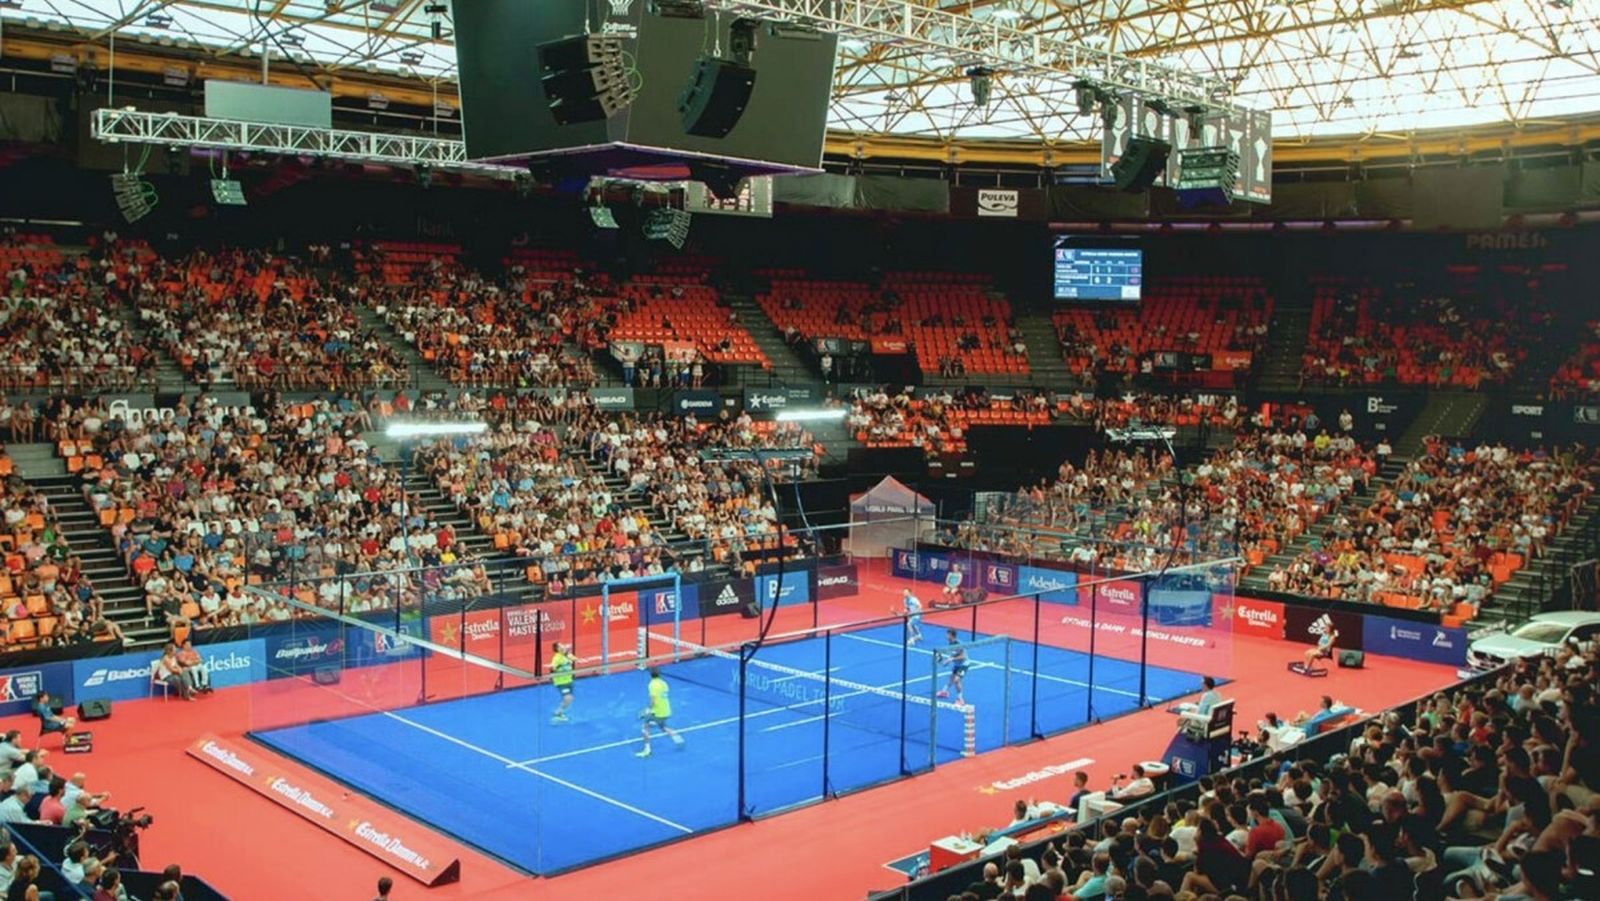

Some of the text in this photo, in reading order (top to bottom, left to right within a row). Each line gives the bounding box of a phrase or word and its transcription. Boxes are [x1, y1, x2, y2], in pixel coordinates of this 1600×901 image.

[980, 192, 1016, 201] PULEVA
[1512, 405, 1543, 416] SPORT
[906, 506, 922, 514] TOR
[818, 575, 849, 587] HEAD
[1100, 585, 1135, 601] Estrella
[715, 596, 740, 607] adidas
[508, 611, 550, 626] VALENIA
[1238, 605, 1277, 623] Estrella
[459, 619, 499, 635] Estrella
[1061, 616, 1100, 629] ESTRELA
[1308, 626, 1339, 638] ads
[204, 652, 251, 672] deslas
[107, 667, 151, 681] Babol
[772, 681, 809, 702] PADEL
[271, 778, 302, 801] Estrella
[296, 792, 325, 813] Damm
[355, 821, 390, 848] Estrella
[386, 838, 419, 863] Damm
